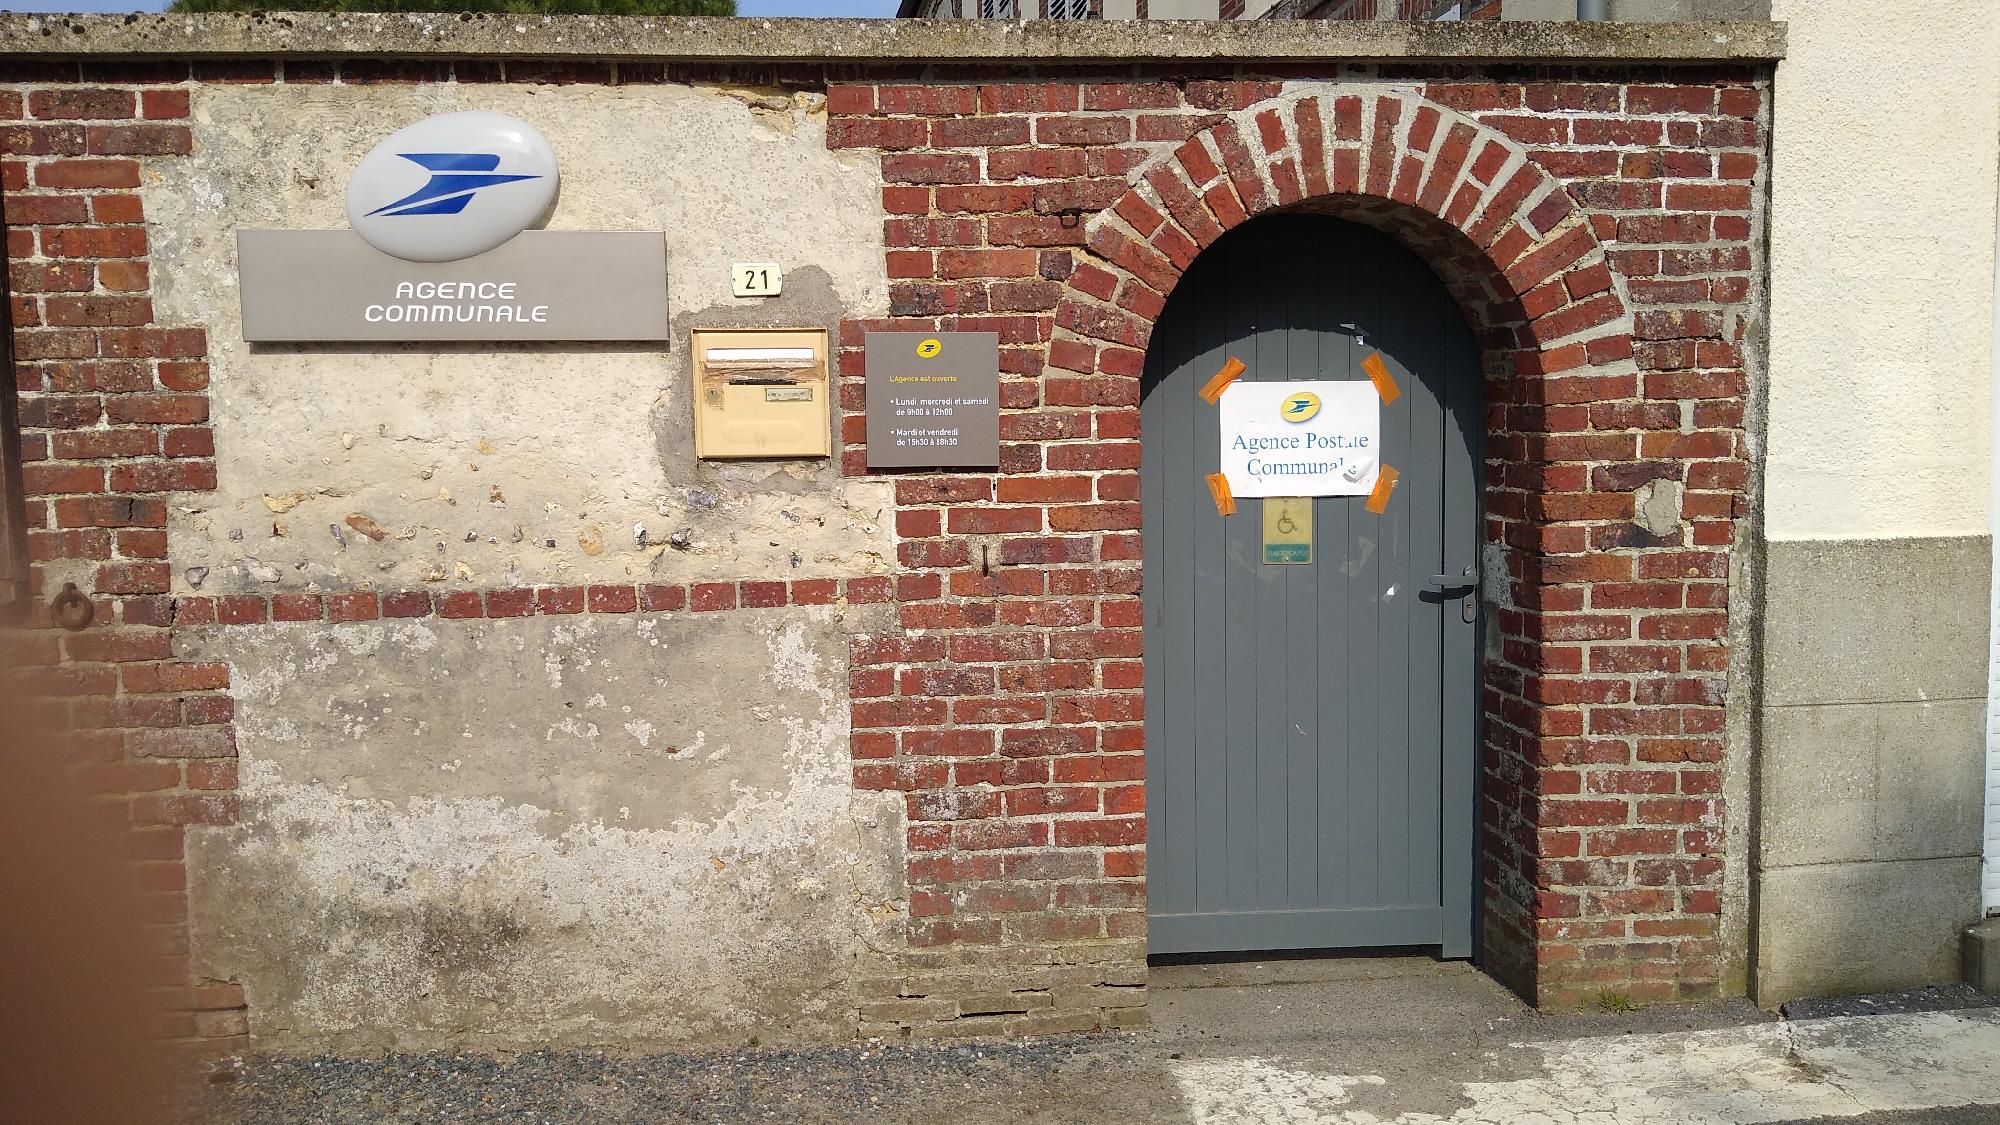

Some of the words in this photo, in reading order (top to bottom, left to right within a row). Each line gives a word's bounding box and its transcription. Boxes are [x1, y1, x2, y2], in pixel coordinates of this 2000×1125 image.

[745, 269, 768, 290] 21
[395, 281, 517, 300] AGENCE
[364, 304, 549, 323] COMMUNALE
[920, 397, 953, 405] mercredi
[954, 397, 961, 405] et
[962, 397, 989, 405] samedi
[896, 408, 906, 416] de
[906, 408, 924, 416] 9h00
[925, 408, 930, 416] à
[932, 408, 953, 416] 12h00
[896, 428, 918, 436] Mardi
[918, 428, 926, 436] et
[926, 428, 958, 436] vendredi
[896, 438, 906, 446] de
[907, 438, 929, 446] 15h30
[929, 438, 935, 446] à
[936, 438, 958, 446] 18h30
[1232, 434, 1300, 454] Agence
